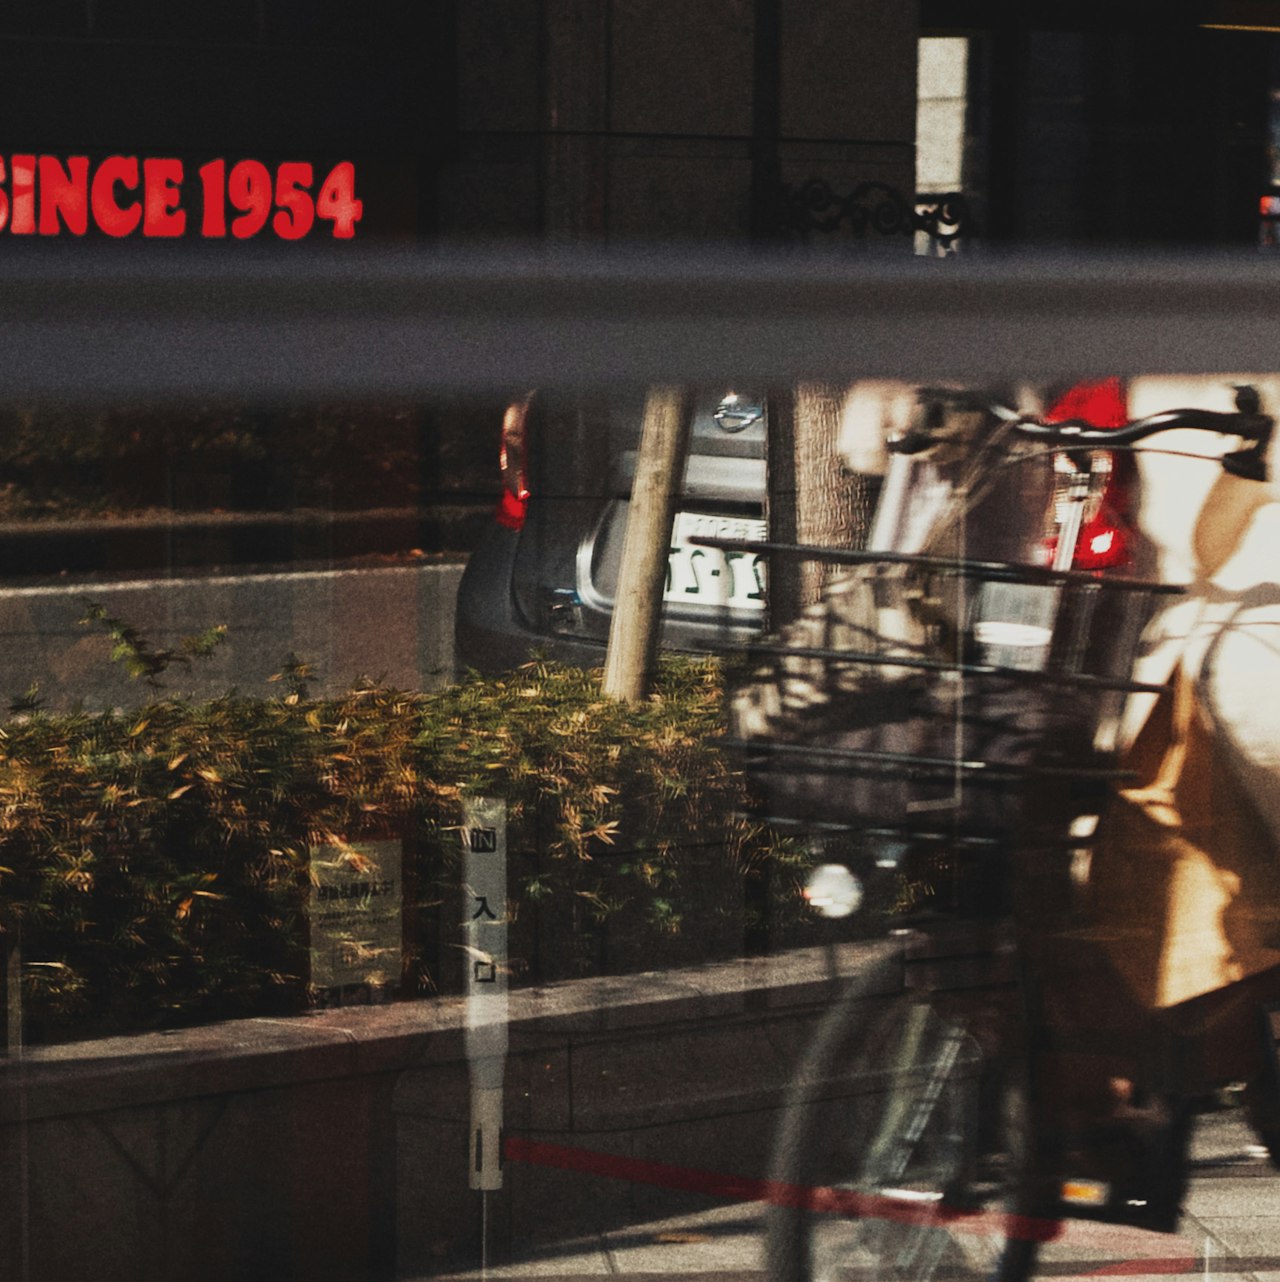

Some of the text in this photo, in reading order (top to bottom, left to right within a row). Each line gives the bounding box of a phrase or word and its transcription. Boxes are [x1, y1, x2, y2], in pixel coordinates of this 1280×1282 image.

[198, 159, 365, 241] 1954
[471, 828, 496, 853] IN
[472, 896, 497, 983] 入口
